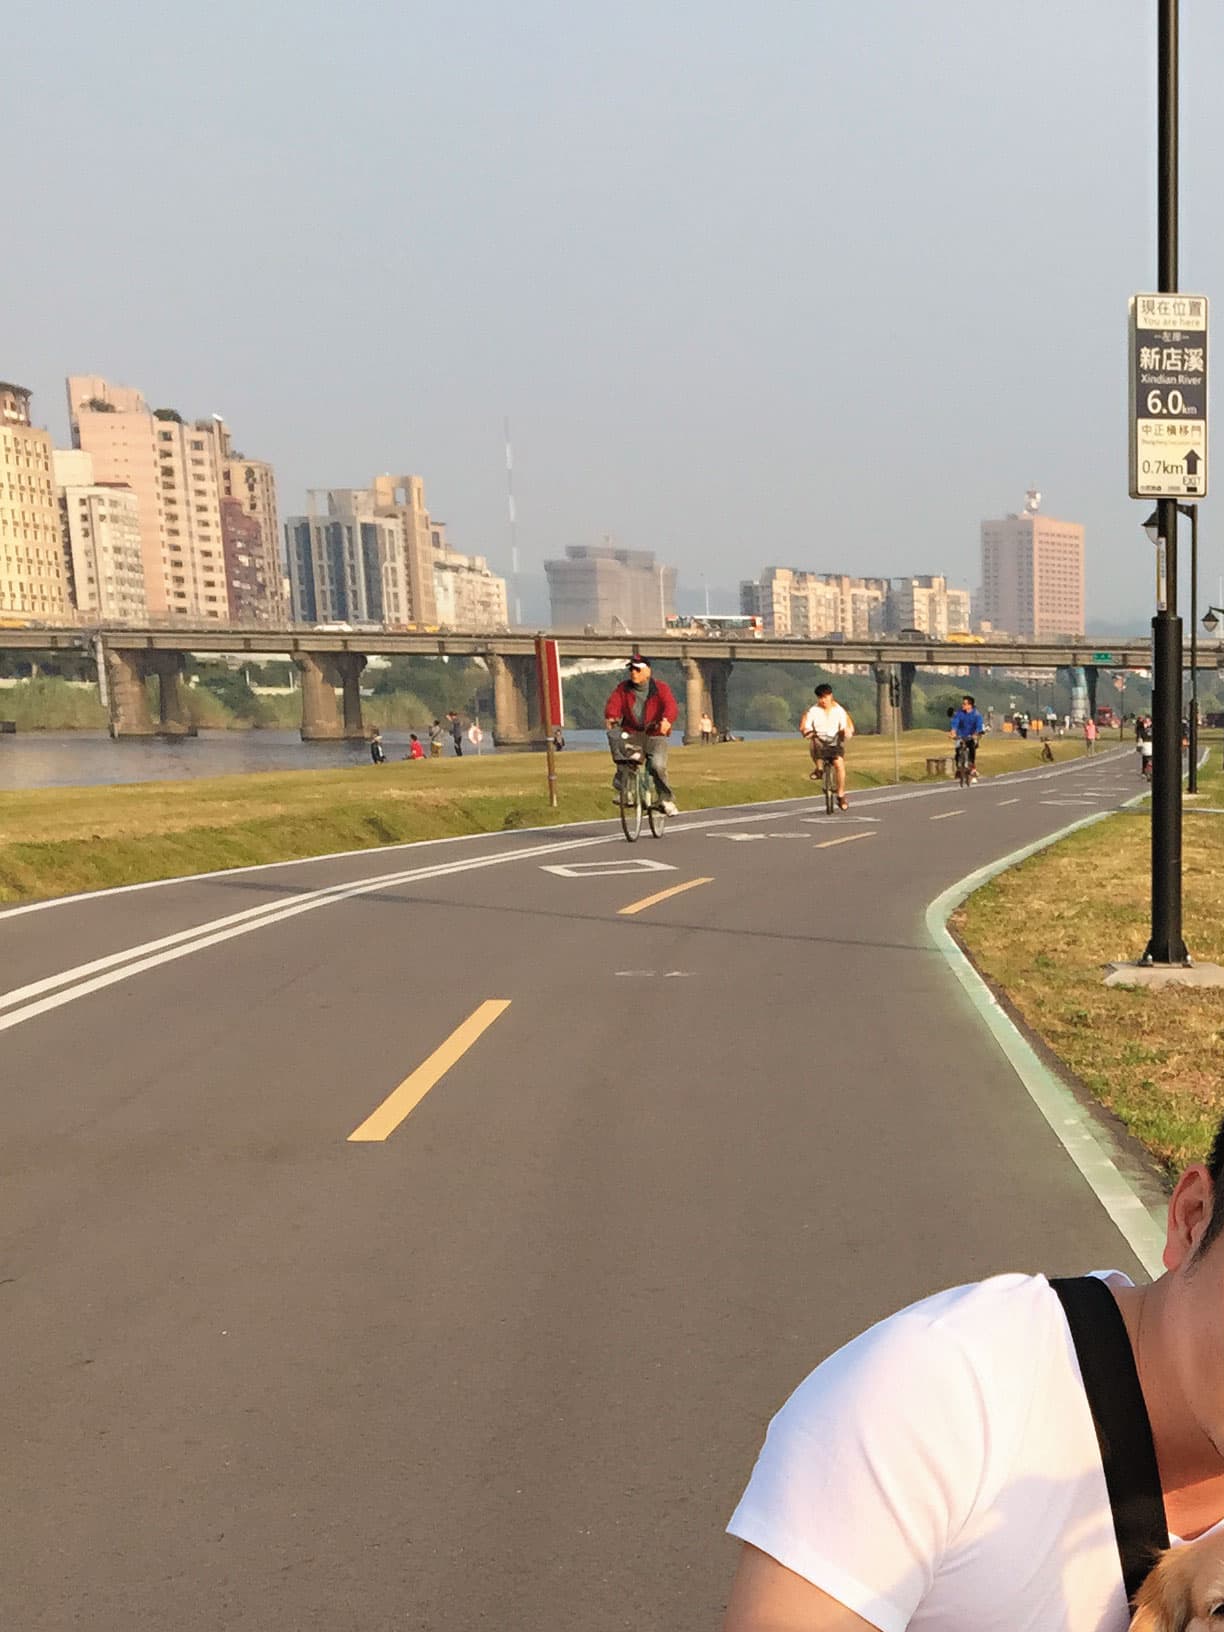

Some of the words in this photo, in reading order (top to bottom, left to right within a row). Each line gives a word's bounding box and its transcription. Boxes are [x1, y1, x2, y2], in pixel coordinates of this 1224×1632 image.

[1142, 299, 1202, 317] 現在位置
[1140, 346, 1204, 372] 新店溪
[1141, 374, 1177, 385] Xindian
[1178, 375, 1202, 385] River
[1142, 460, 1184, 475] 0.7km
